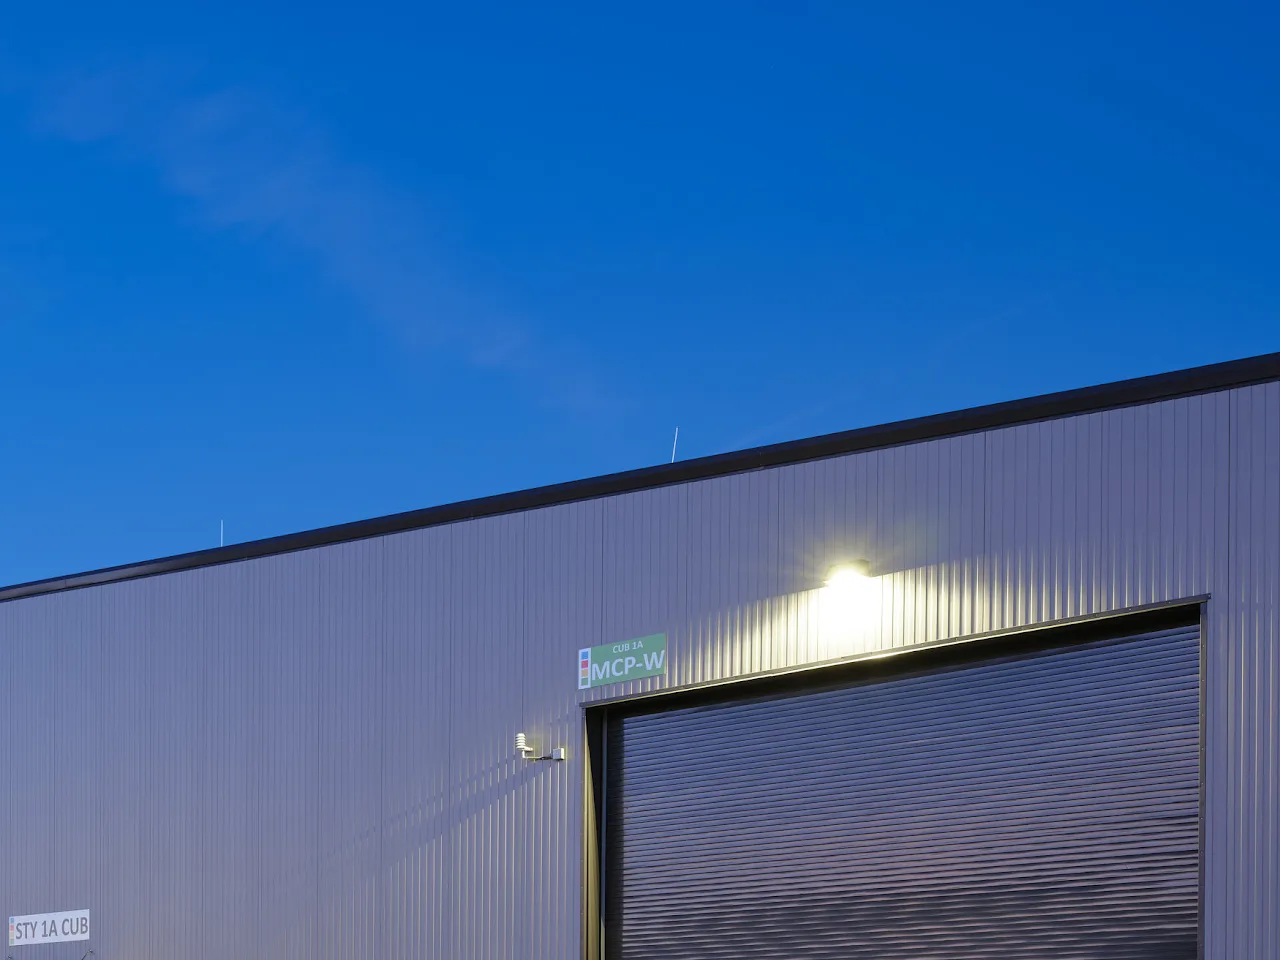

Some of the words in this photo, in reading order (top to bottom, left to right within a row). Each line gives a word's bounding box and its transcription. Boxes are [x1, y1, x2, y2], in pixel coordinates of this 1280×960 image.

[613, 642, 630, 653] CUB
[632, 641, 643, 650] 1A
[592, 650, 665, 680] MCP-W
[16, 921, 37, 939] STY
[42, 920, 58, 938] 1A
[62, 917, 88, 936] CUB
